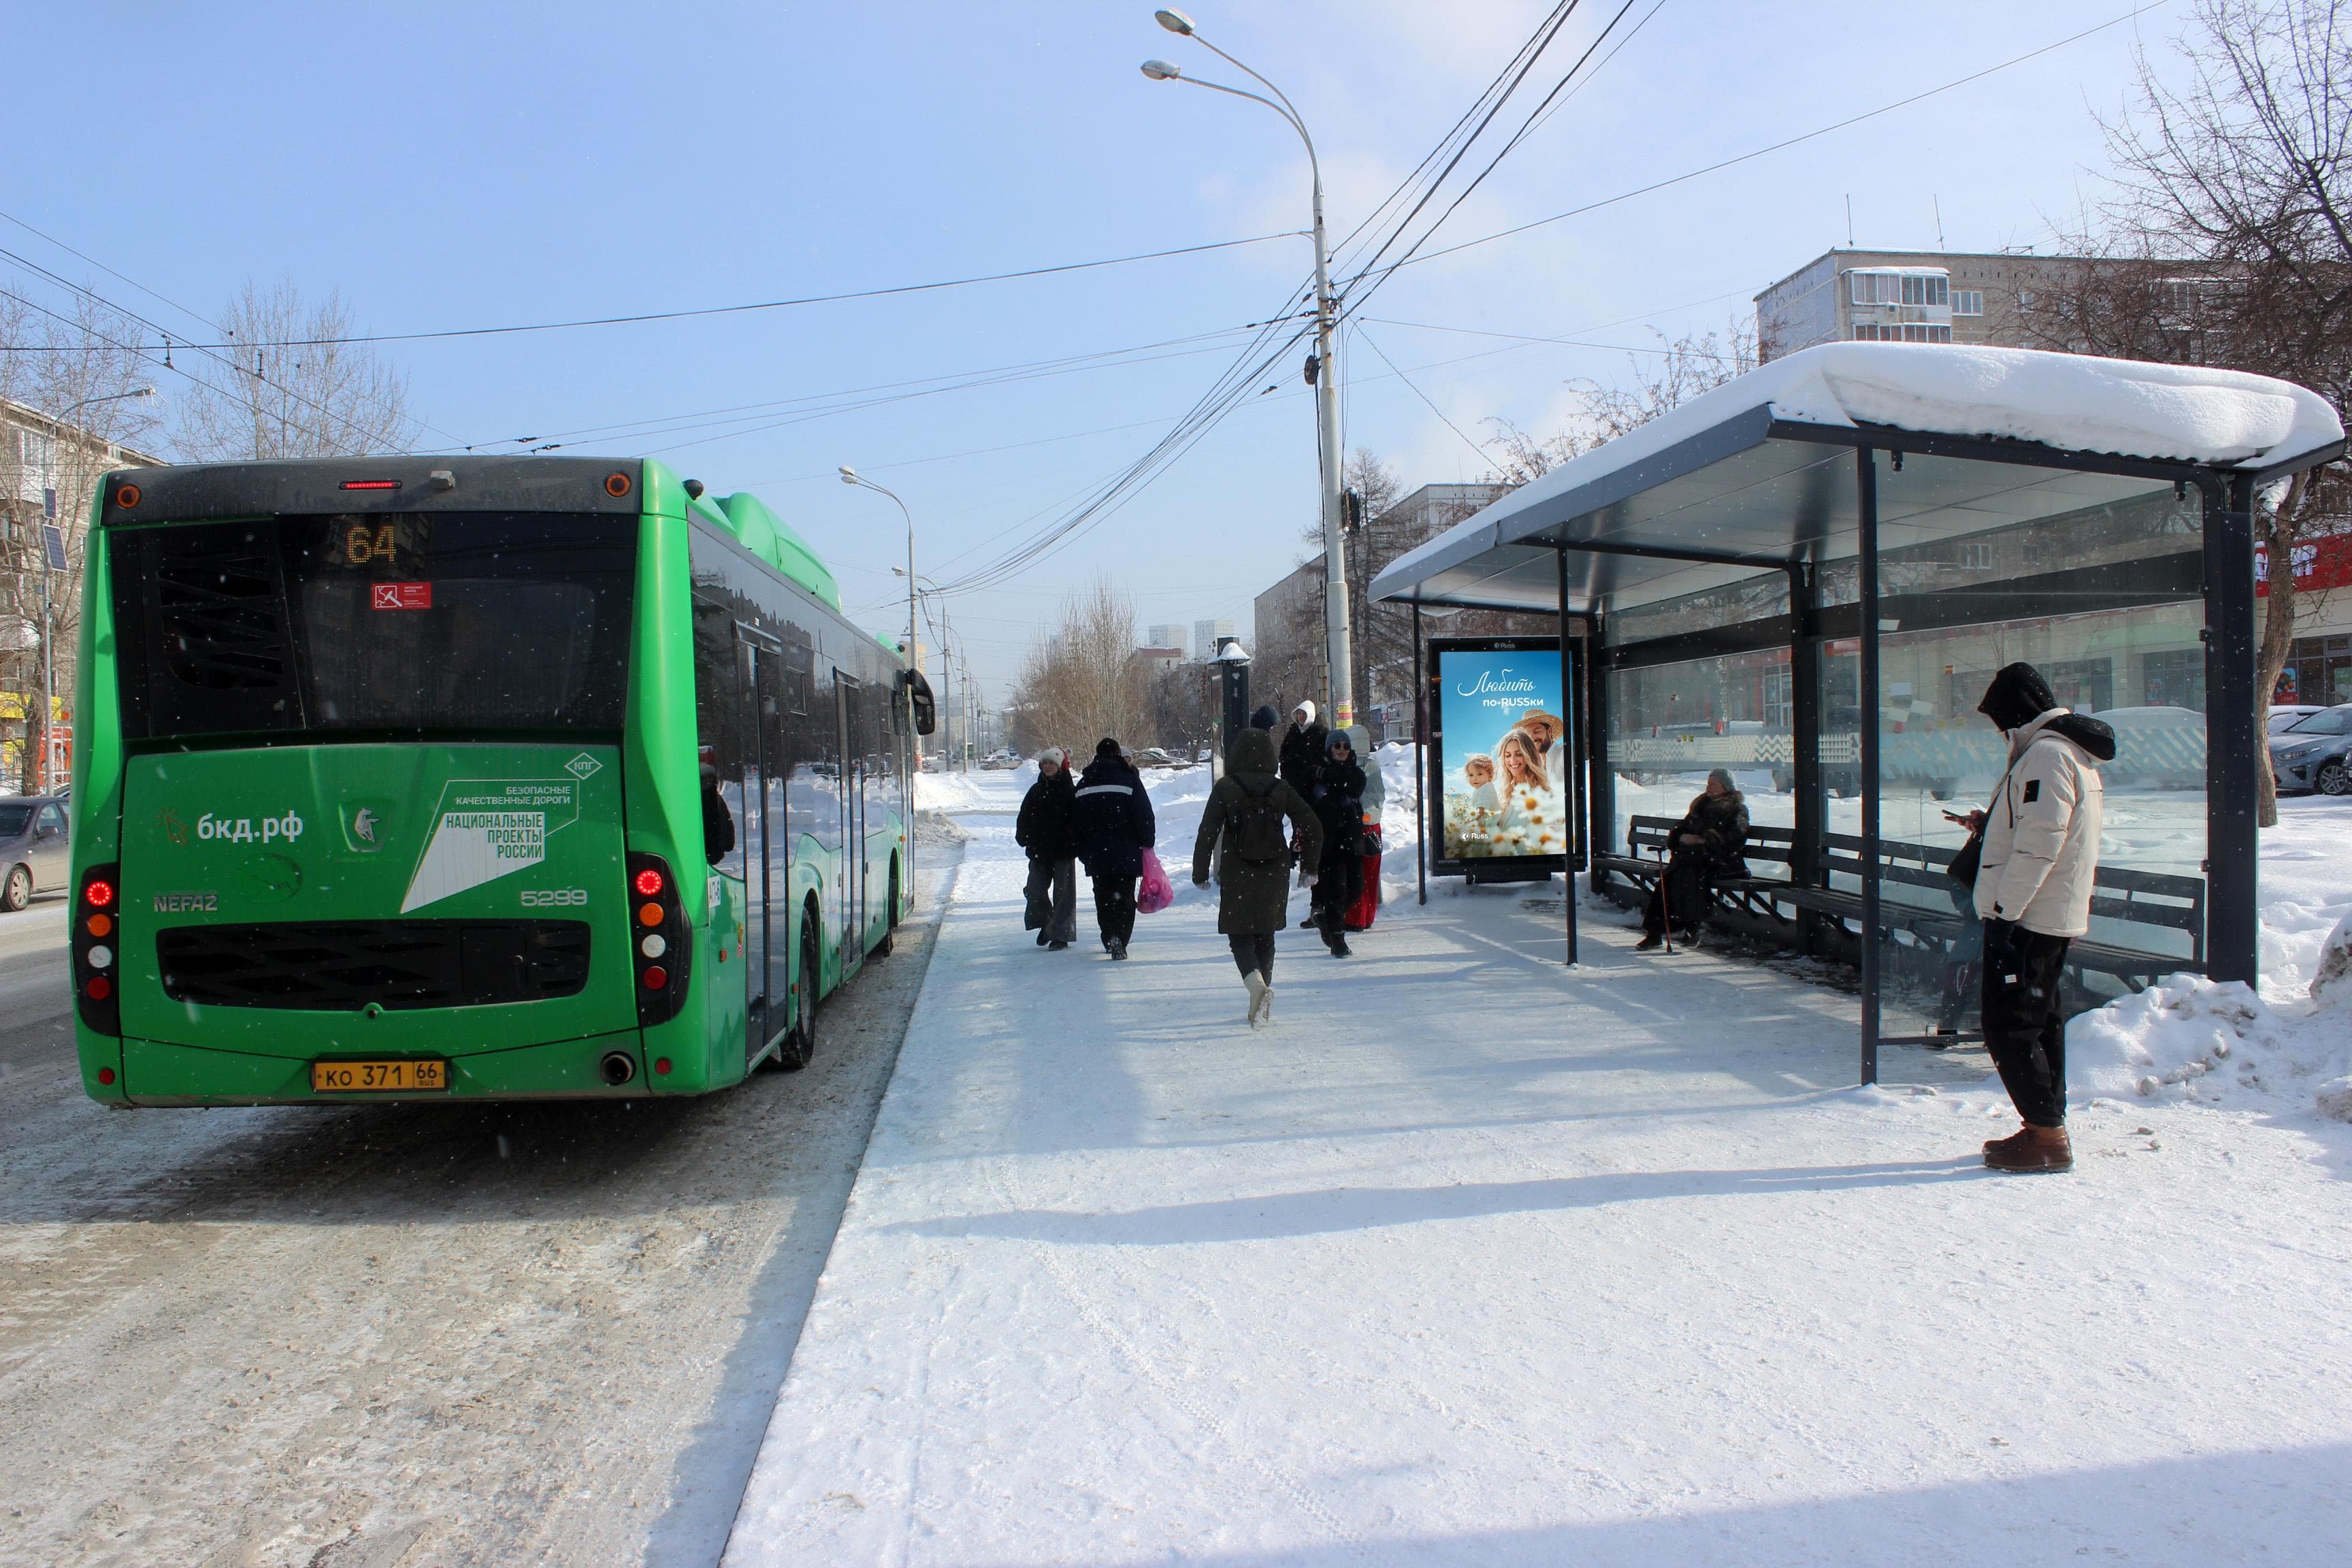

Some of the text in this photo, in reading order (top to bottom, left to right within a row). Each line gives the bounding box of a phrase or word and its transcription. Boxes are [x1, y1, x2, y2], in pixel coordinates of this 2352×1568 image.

[348, 526, 396, 564] 64
[1458, 669, 1536, 696] Любить
[1483, 698, 1544, 706] по-RUSSки
[574, 762, 594, 770] КПГ
[506, 786, 571, 795] БЕЗОПАСНЫЕ
[455, 796, 571, 806] КАЧЕСТВЕННЫЕ ДОРОГИ
[197, 810, 304, 843] бкд.рф
[446, 814, 542, 830] НАЦИОНАЛЬНЫЕ
[487, 829, 542, 844] ПРОЕКТЫ
[497, 845, 542, 859] РОССИИ
[154, 893, 218, 913] NEFAZ
[521, 889, 588, 906] 5299
[362, 1064, 402, 1086] 371
[416, 1062, 437, 1079] 66
